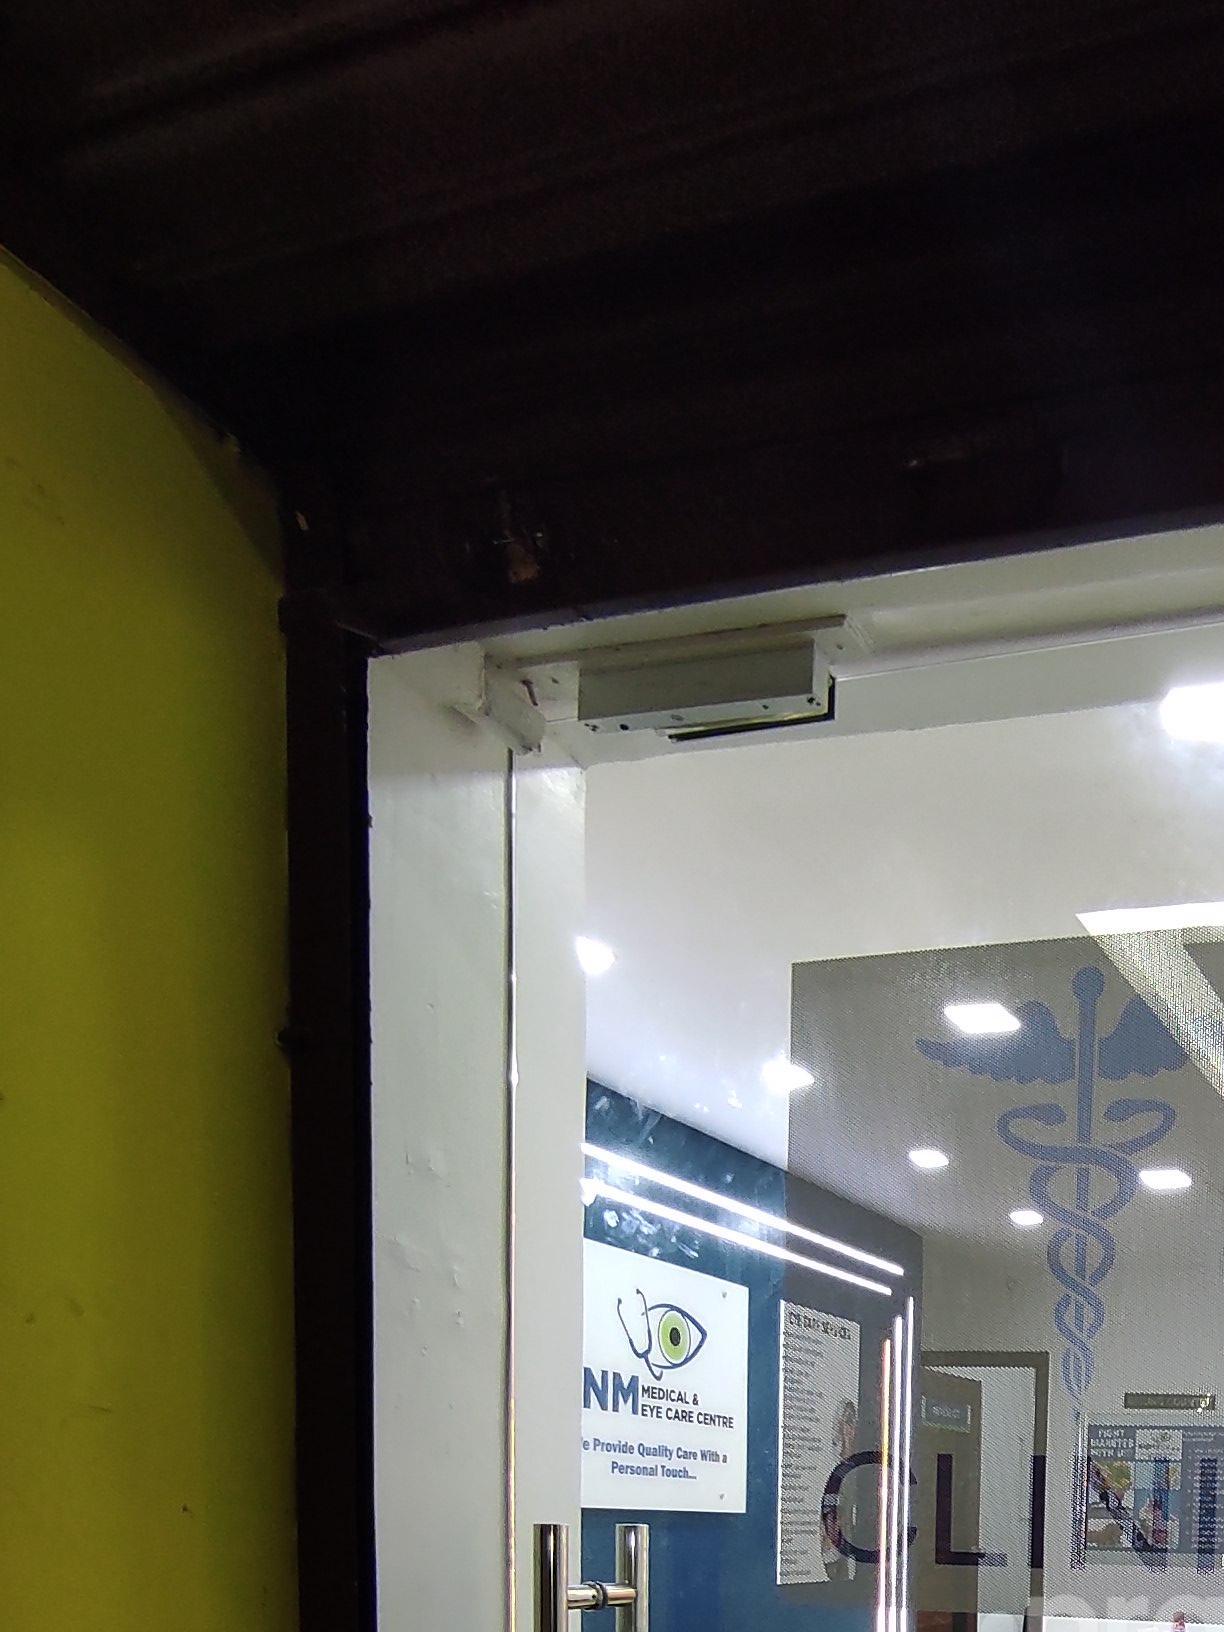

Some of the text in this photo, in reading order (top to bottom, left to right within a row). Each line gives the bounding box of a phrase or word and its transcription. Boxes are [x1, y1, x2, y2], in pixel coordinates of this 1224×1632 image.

[583, 1366, 640, 1416] NM
[641, 1385, 699, 1406] MEDICAL &
[641, 1404, 735, 1429] EYE CARE CENTRE
[593, 1438, 635, 1455] Provide
[637, 1443, 674, 1461] Quality
[676, 1447, 698, 1461] Care
[700, 1449, 720, 1463] With
[722, 1454, 728, 1464] a
[611, 1461, 658, 1477] Personal
